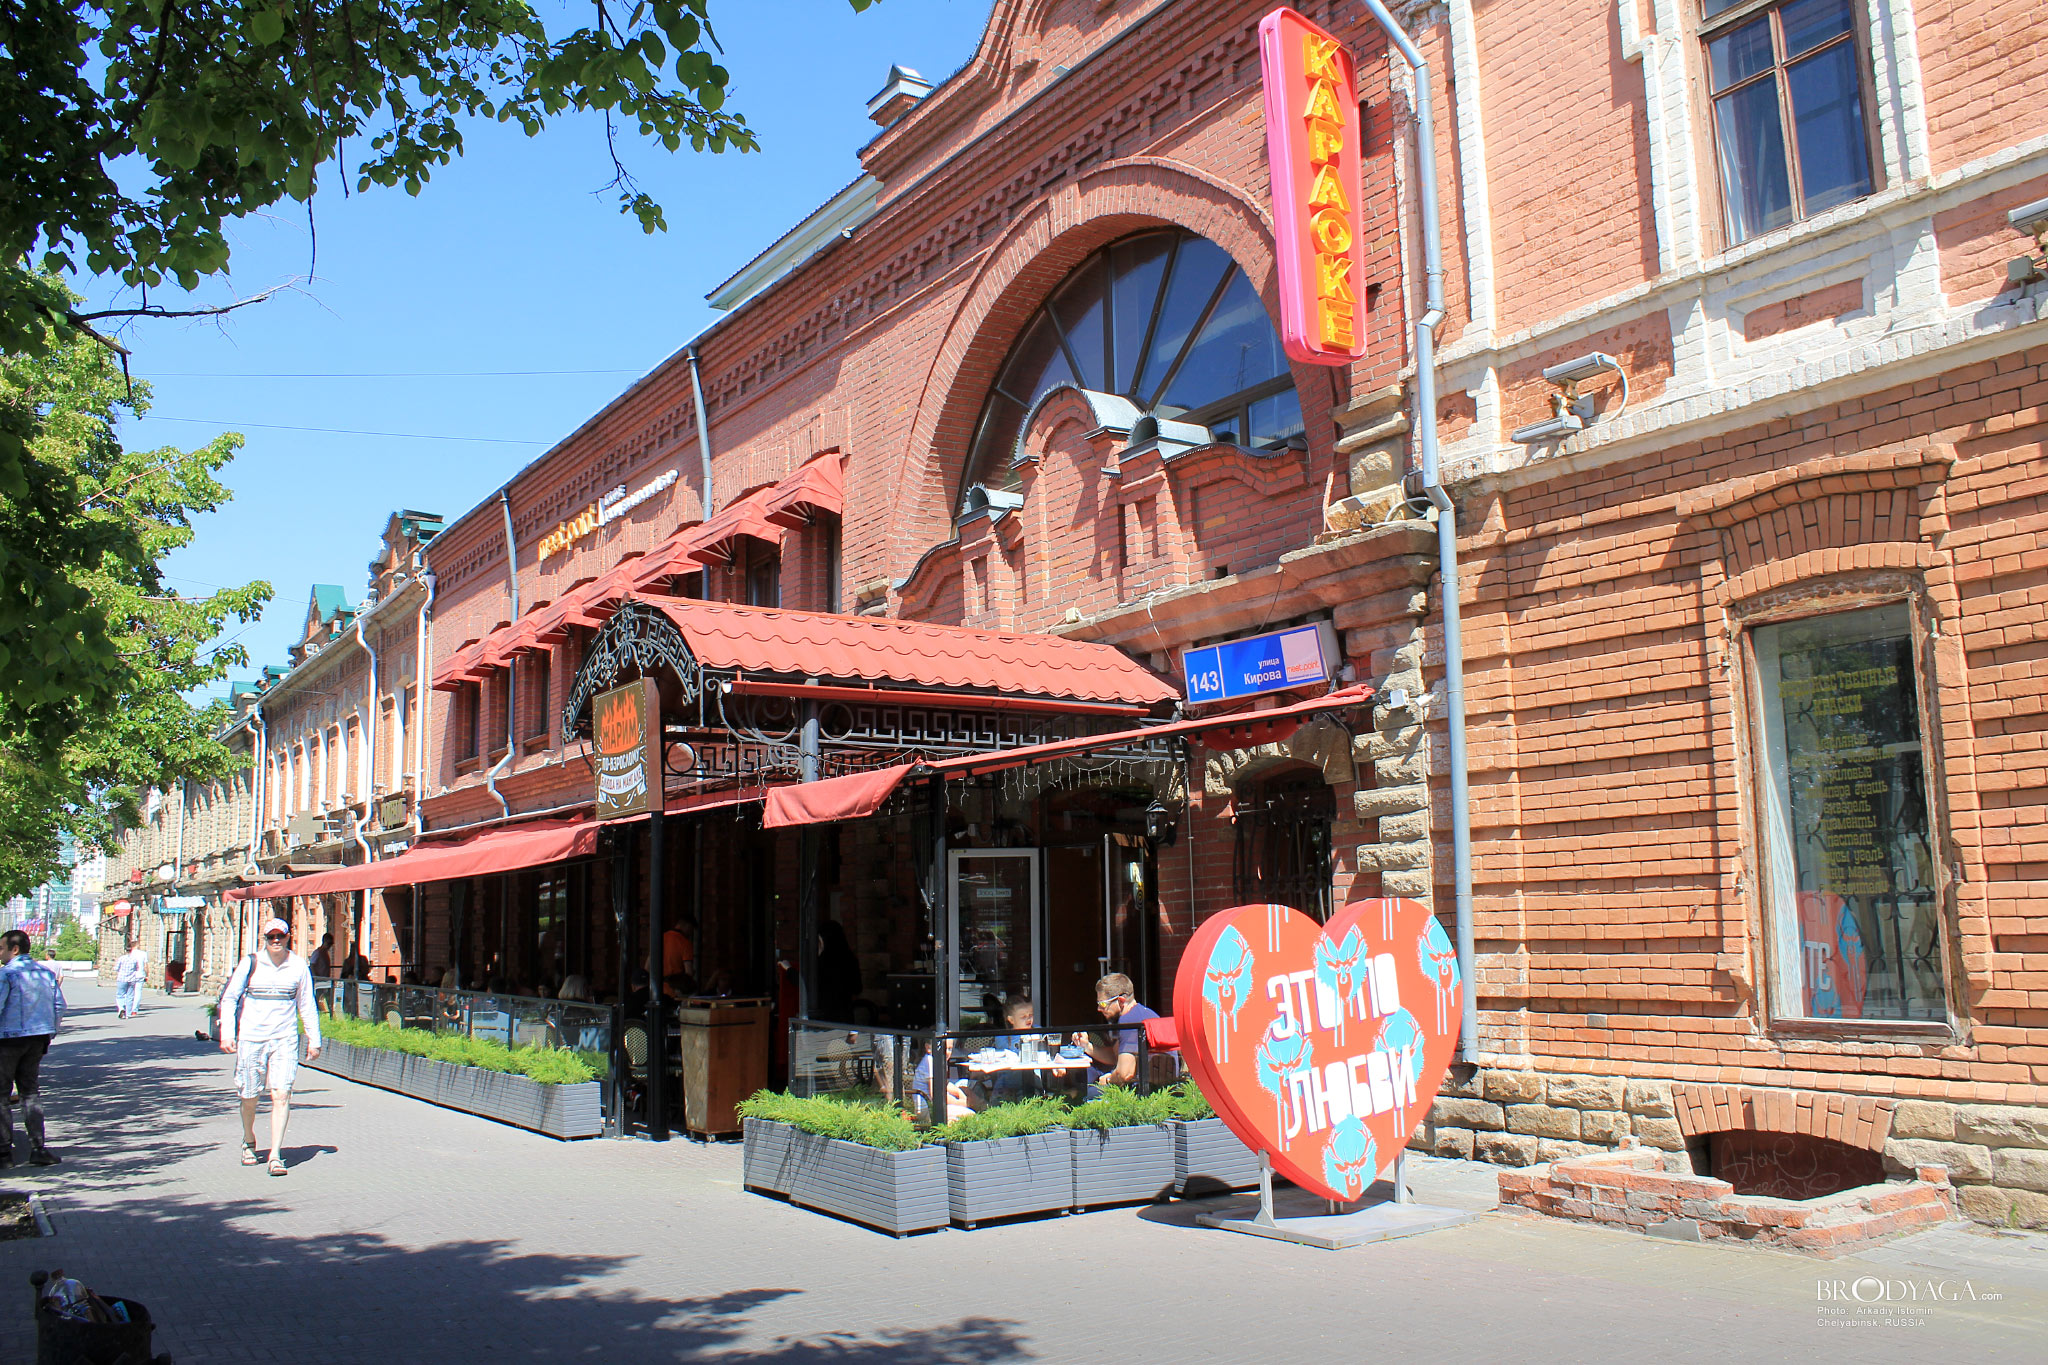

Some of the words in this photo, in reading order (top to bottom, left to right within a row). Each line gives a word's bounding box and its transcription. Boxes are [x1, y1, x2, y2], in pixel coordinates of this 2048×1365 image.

[1303, 32, 1357, 350] КАРАОКЕ
[1258, 657, 1280, 669] улица
[1191, 670, 1219, 694] 143
[1244, 669, 1282, 685] Кирова
[1813, 694, 1862, 716] КРАСКИ
[602, 716, 638, 752] ЖАРИМ
[1820, 850, 1849, 866] усы
[1267, 967, 1343, 1041] ЭТО
[1350, 953, 1401, 1021] ПО
[1286, 1044, 1418, 1141] ЛЮБВИ
